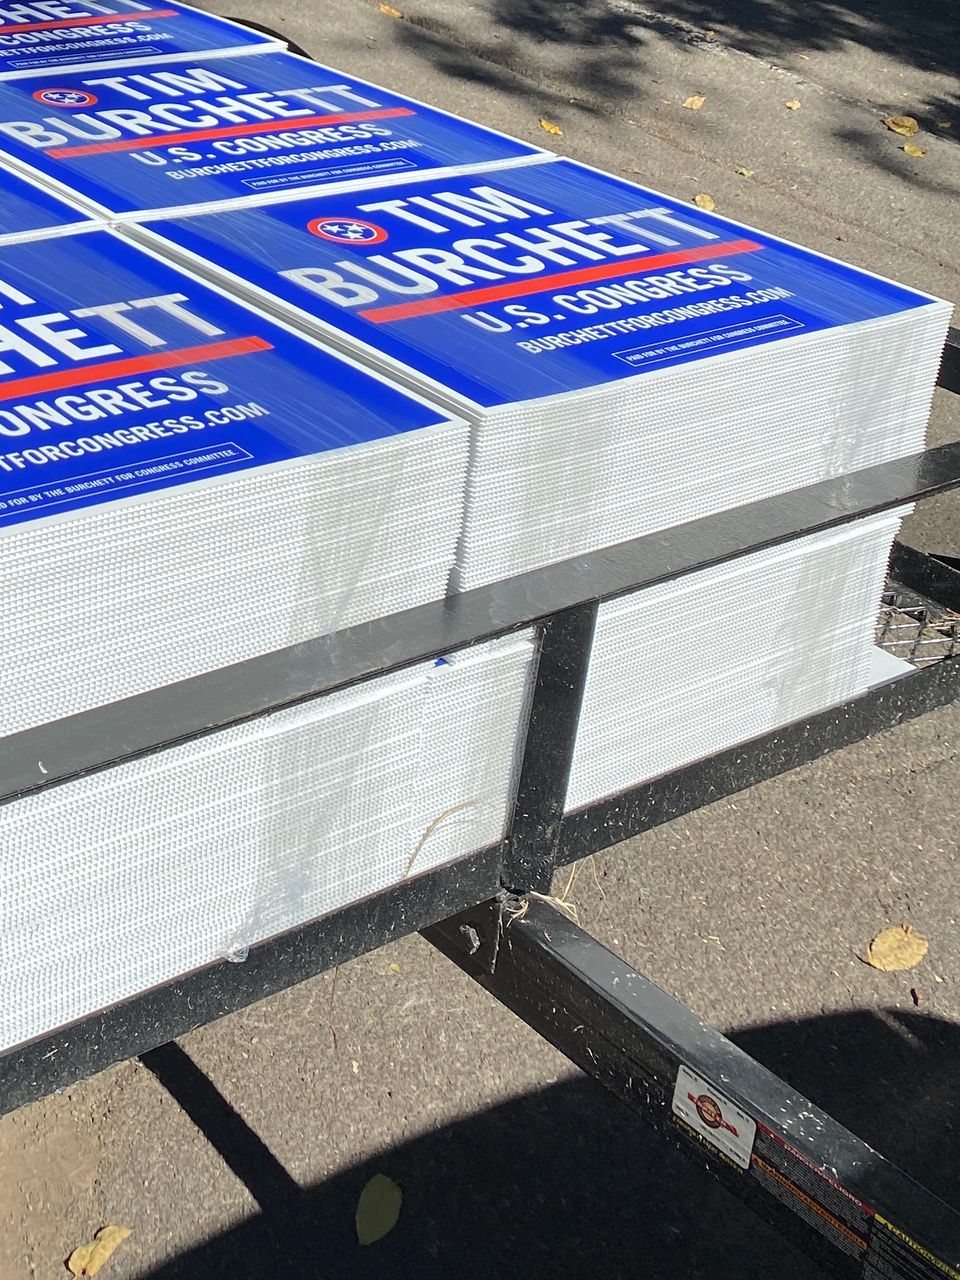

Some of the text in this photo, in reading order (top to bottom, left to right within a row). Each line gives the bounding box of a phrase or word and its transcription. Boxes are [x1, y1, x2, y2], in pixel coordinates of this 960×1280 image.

[82, 68, 246, 99] TIM
[129, 123, 392, 165] U.S. CONGRESS
[165, 139, 424, 179] BURCHETTFORCONGRESS.COM
[357, 185, 552, 233] TIM
[278, 207, 720, 309] BURCHETT
[461, 264, 753, 332] U.S. CONGRESS
[517, 287, 798, 352] BURCHETTFORCONGRESS.COM
[641, 350, 658, 358] FOR
[677, 337, 713, 348] BURCHETT
[7, 496, 30, 506] FOR
[27, 493, 44, 501] BY
[43, 488, 66, 498] THE
[65, 476, 117, 493] BURCHETT
[115, 472, 136, 481] FOR
[136, 460, 185, 477] CONGRESS
